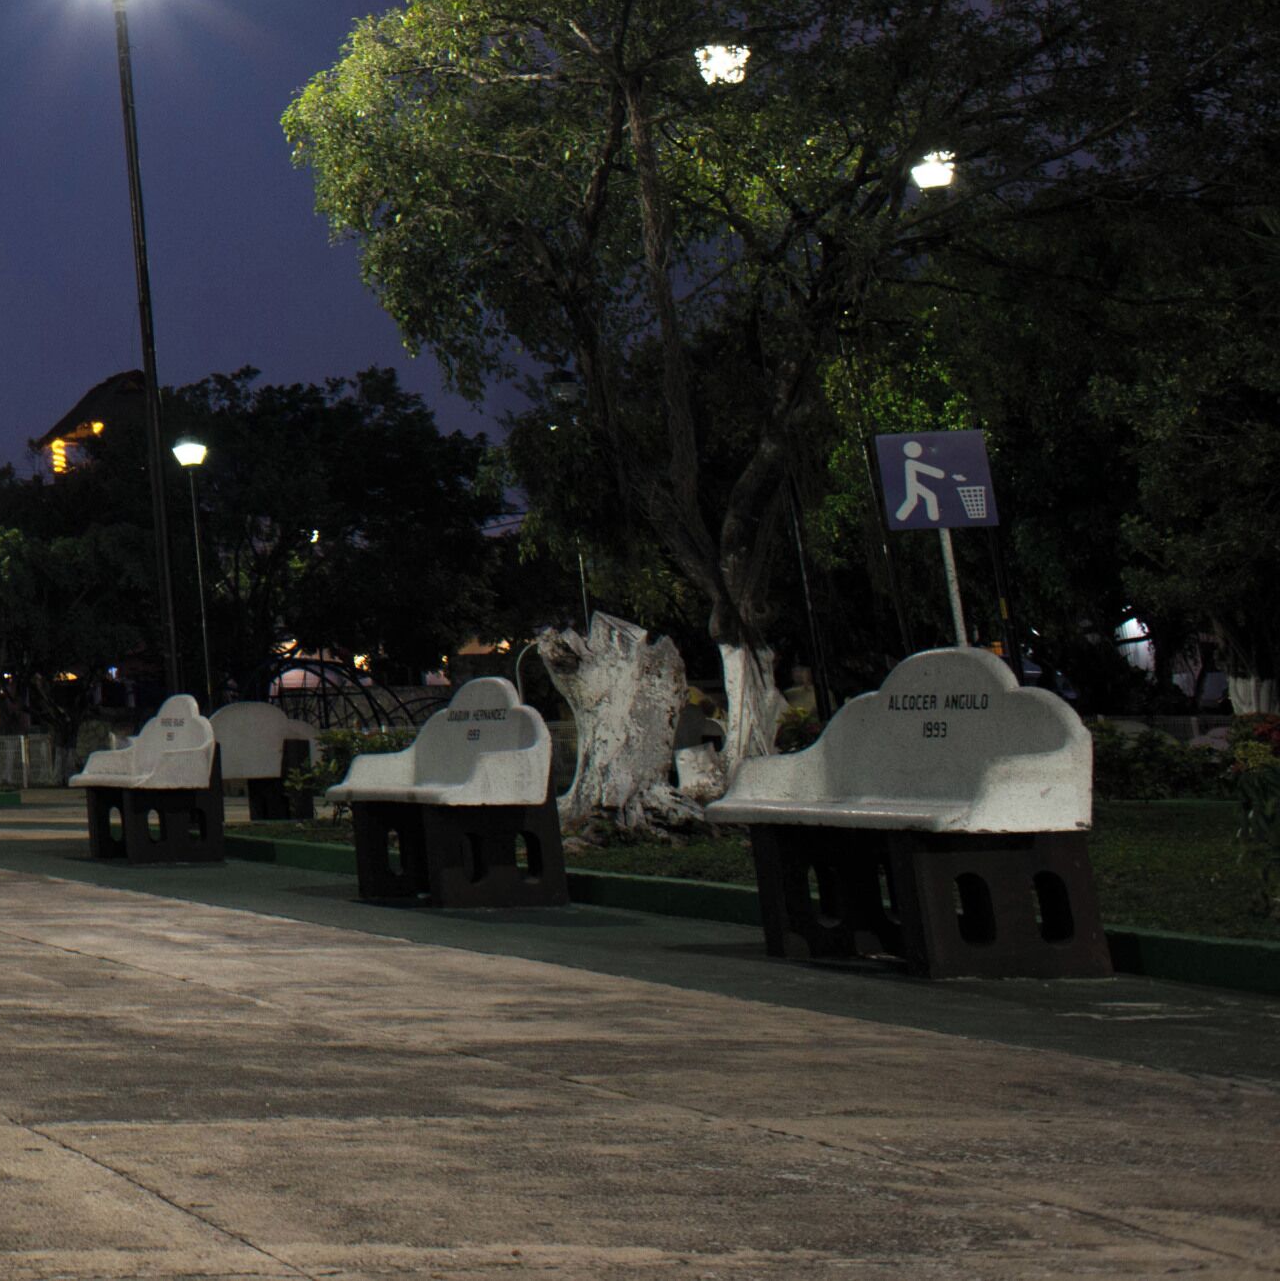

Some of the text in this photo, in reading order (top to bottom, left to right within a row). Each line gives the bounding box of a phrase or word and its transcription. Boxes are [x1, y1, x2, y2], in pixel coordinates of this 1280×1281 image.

[888, 693, 989, 711] ALCOCER ANGULO
[471, 708, 506, 721] HERNANDEZ
[922, 721, 947, 738] 1993
